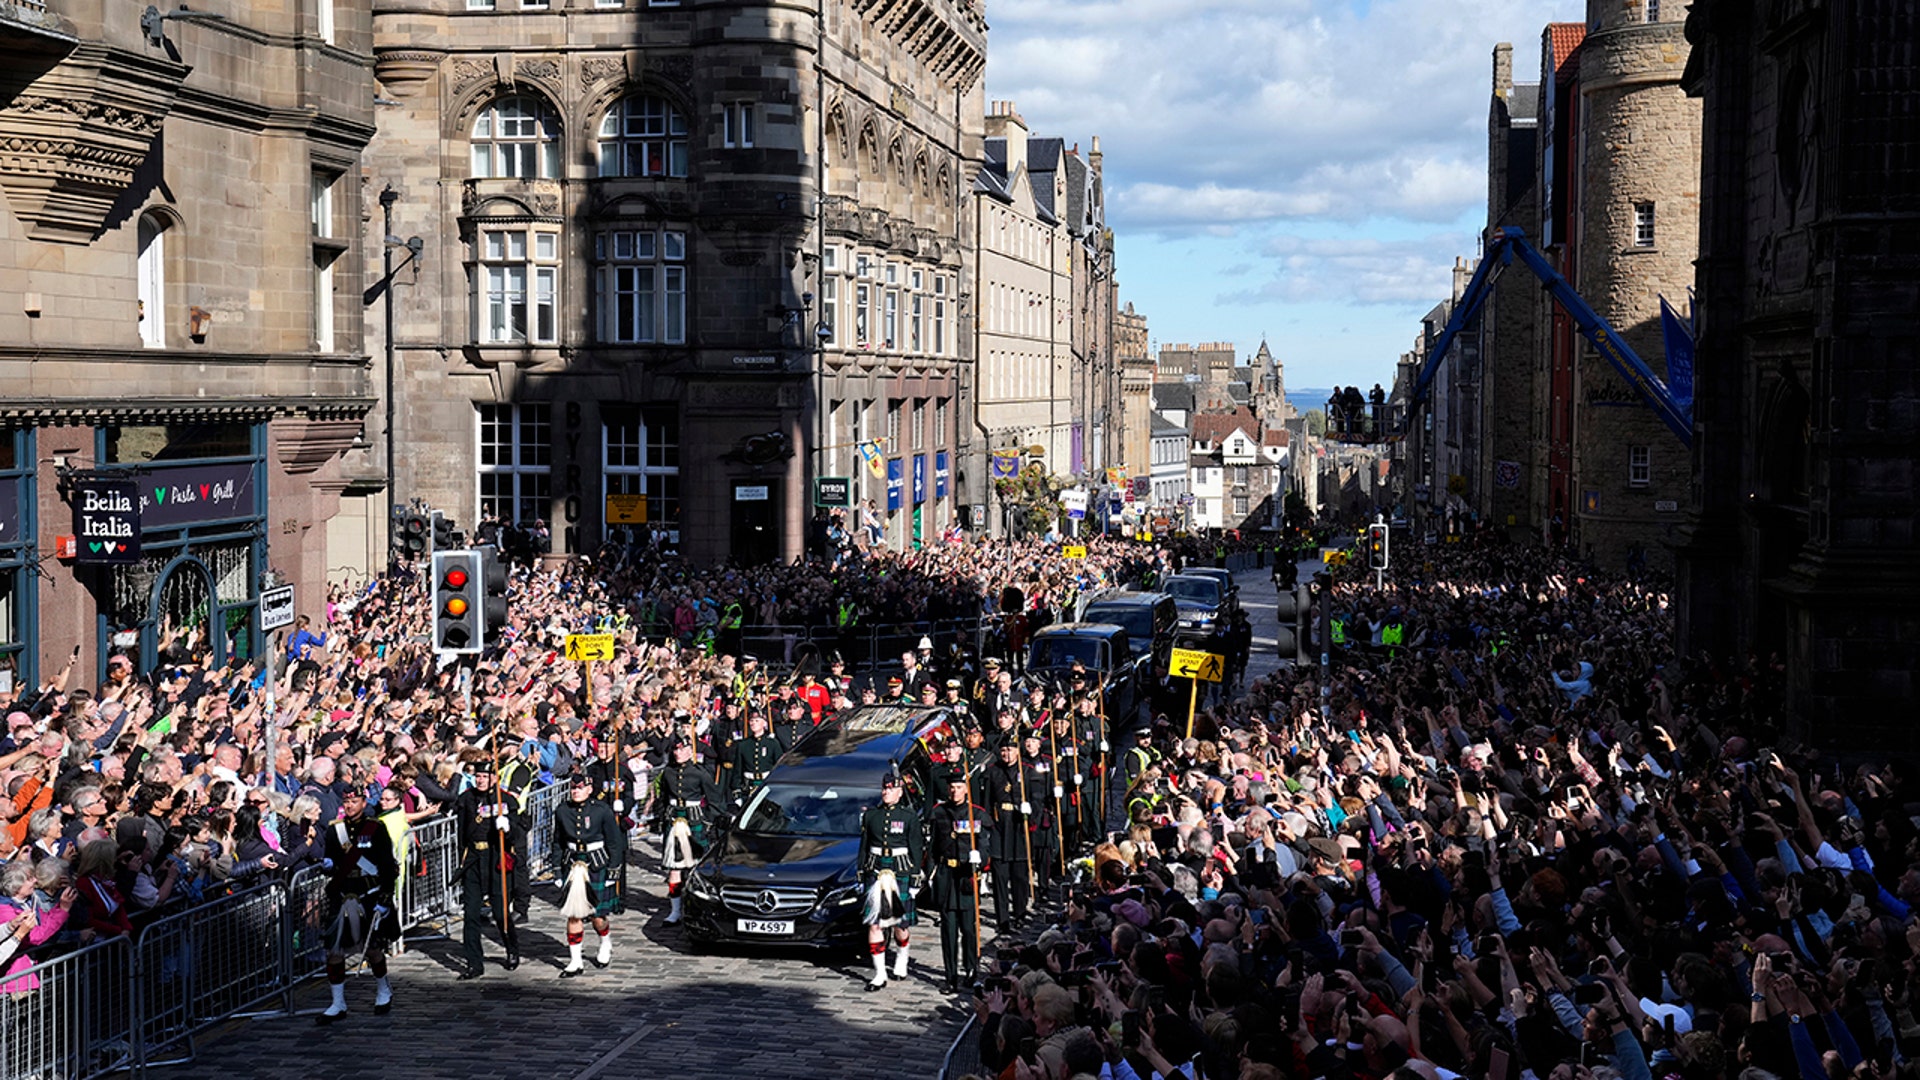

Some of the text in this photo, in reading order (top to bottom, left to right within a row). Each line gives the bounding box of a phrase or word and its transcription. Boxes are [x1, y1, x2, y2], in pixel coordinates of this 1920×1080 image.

[565, 402, 581, 554] BYRON
[820, 484, 846, 493] BYRON
[82, 489, 133, 512] Bella
[172, 484, 197, 504] Pasta
[212, 479, 234, 504] Grill
[82, 515, 134, 537] Italia
[760, 922, 787, 932] 4597
